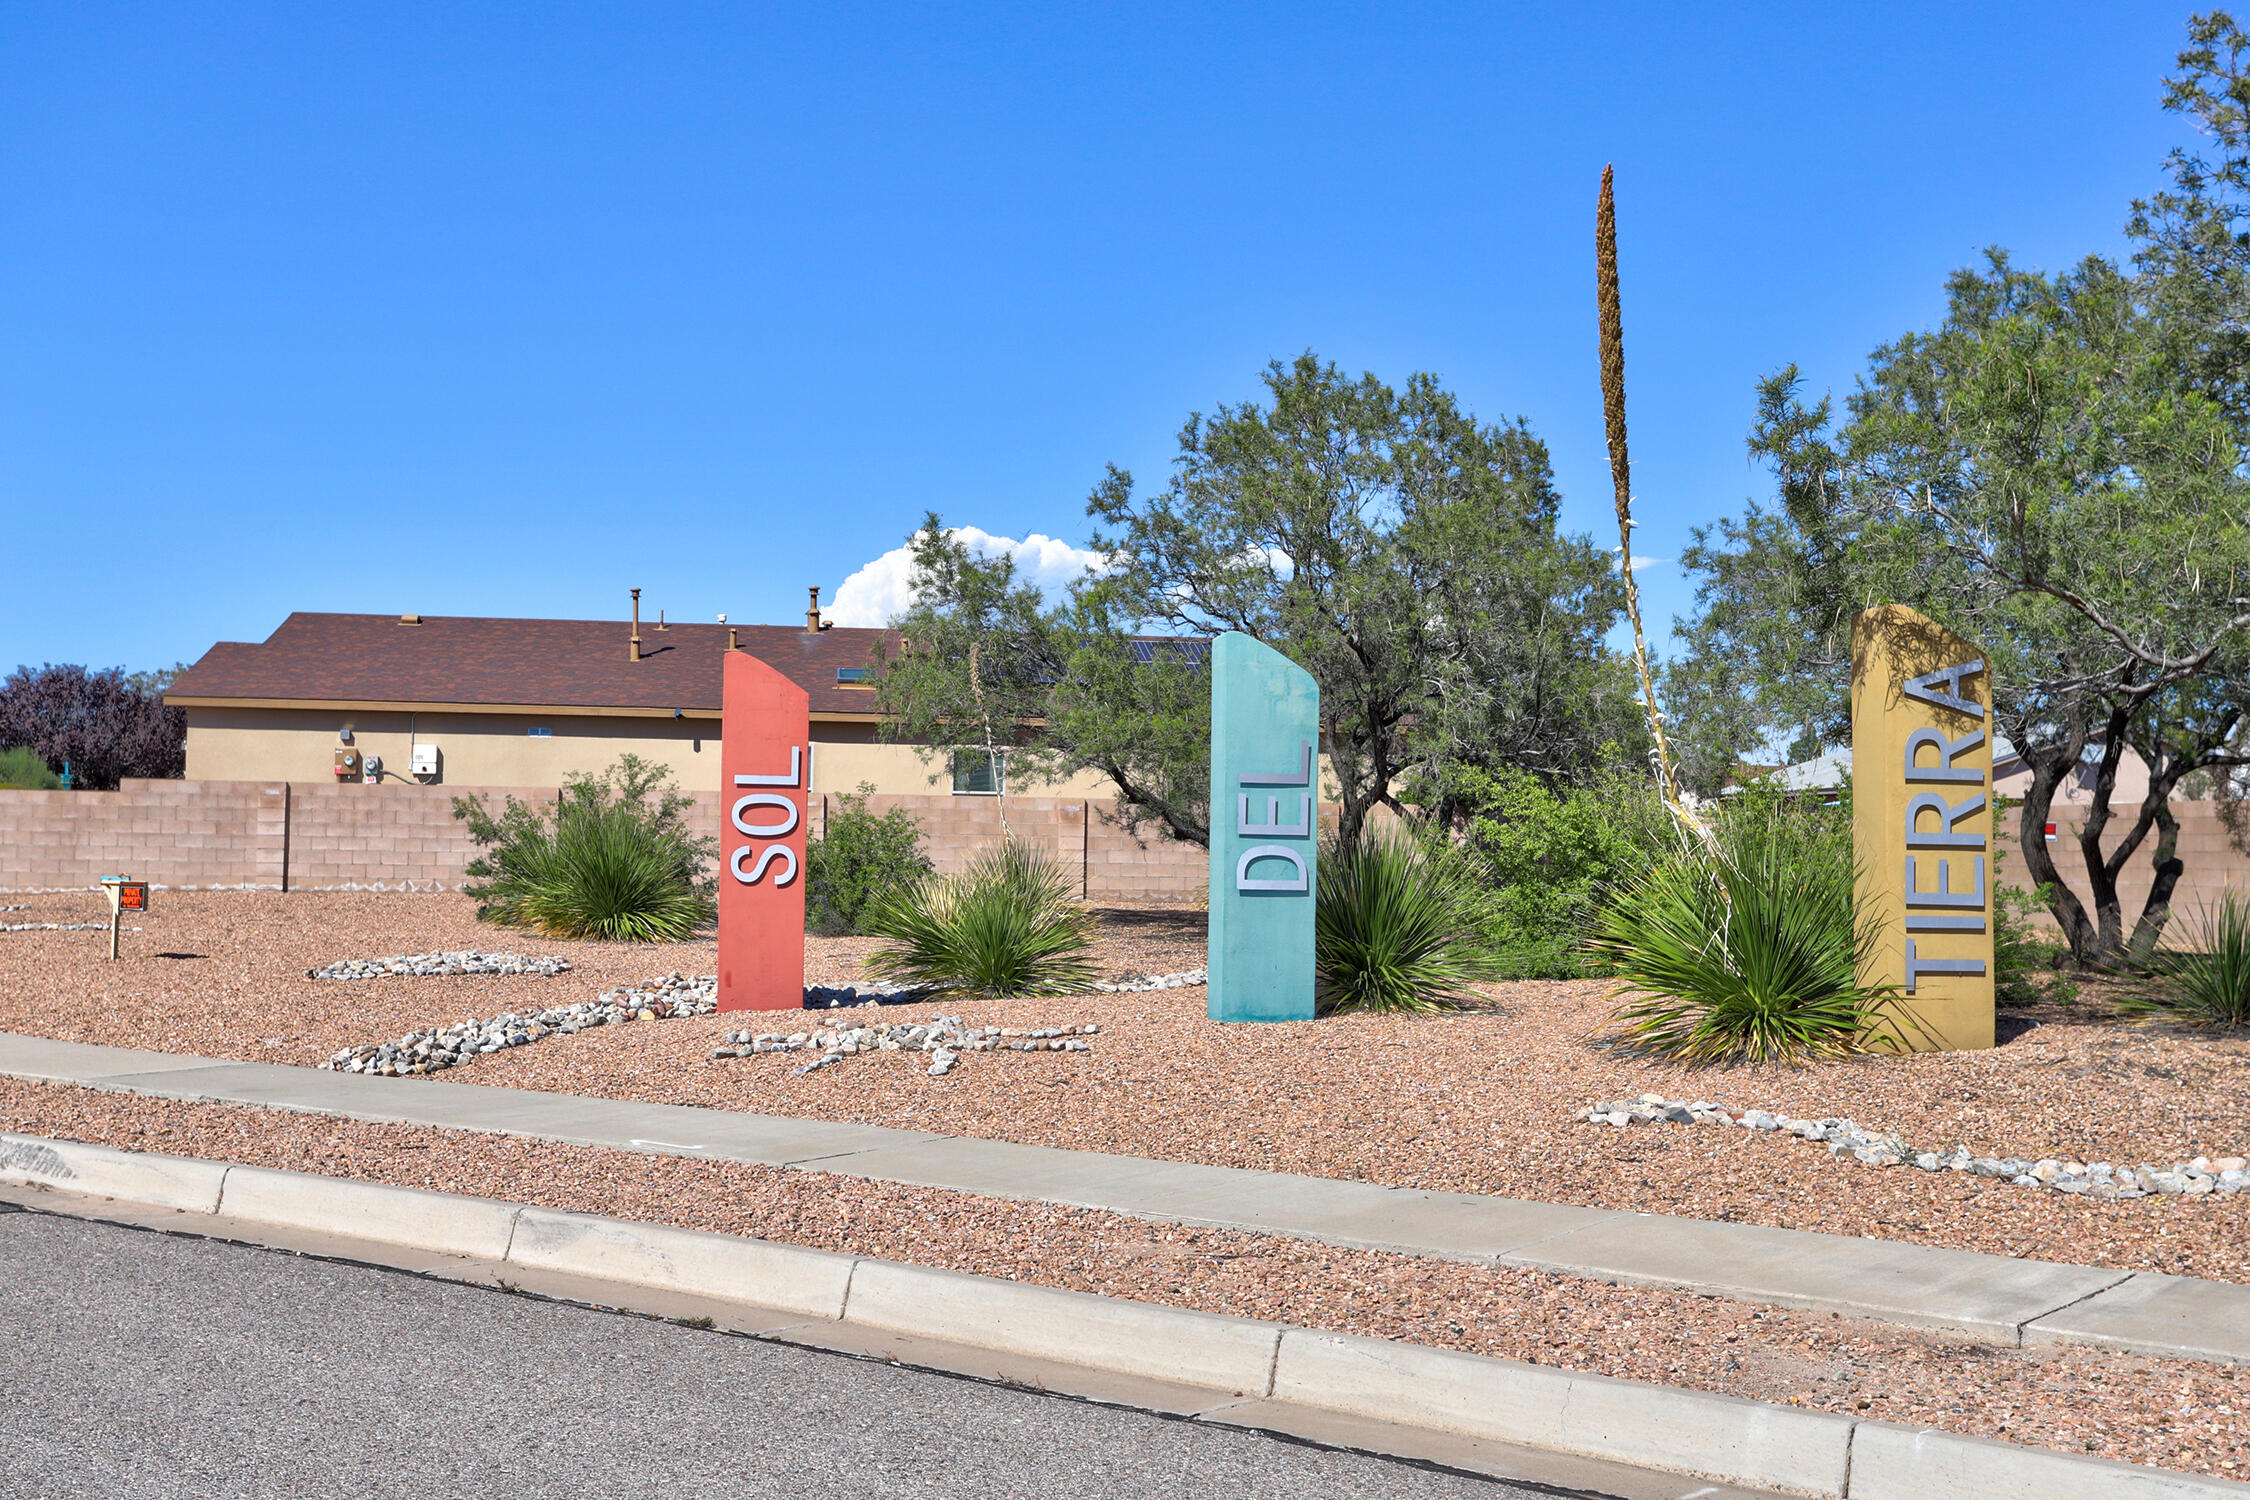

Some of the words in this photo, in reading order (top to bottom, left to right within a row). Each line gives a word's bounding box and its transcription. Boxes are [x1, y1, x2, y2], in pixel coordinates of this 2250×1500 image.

[730, 745, 800, 886] SOL
[1236, 740, 1310, 892] DEL
[1904, 658, 1986, 992] TIERRA
